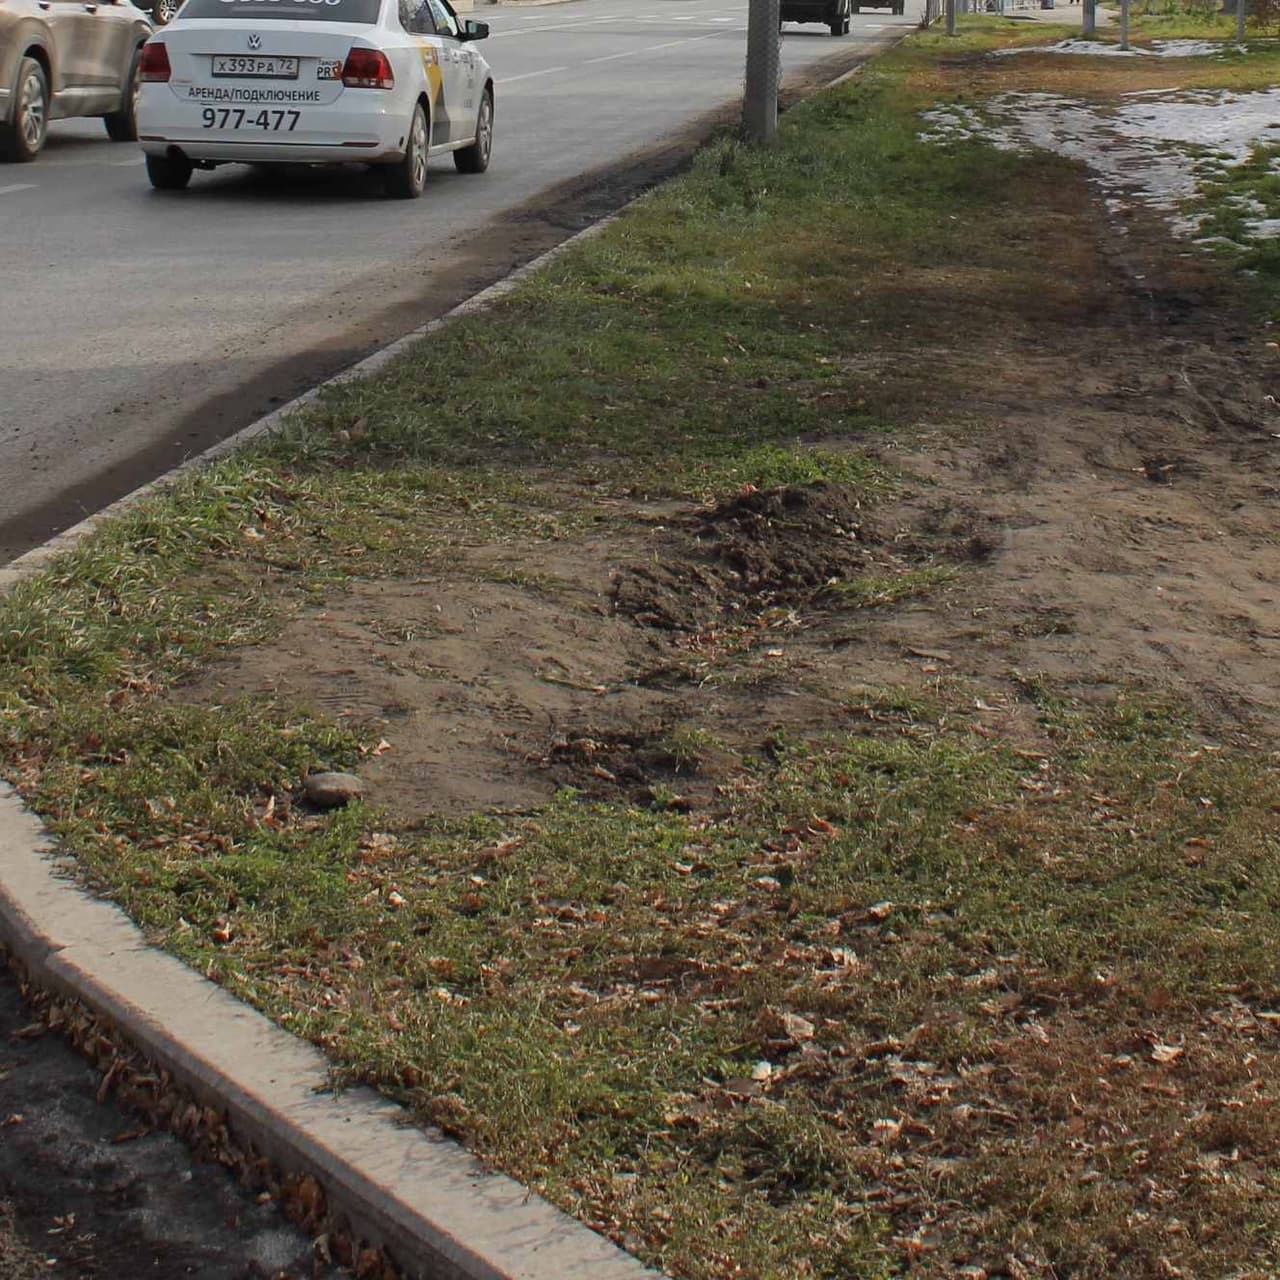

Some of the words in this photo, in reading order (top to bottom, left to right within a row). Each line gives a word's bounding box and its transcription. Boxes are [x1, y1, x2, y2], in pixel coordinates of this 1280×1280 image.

[279, 59, 293, 70] 72
[189, 87, 320, 103] АРЕНДА/ПОДКЛЮЧЕНИЕ
[202, 108, 301, 131] 977-477
